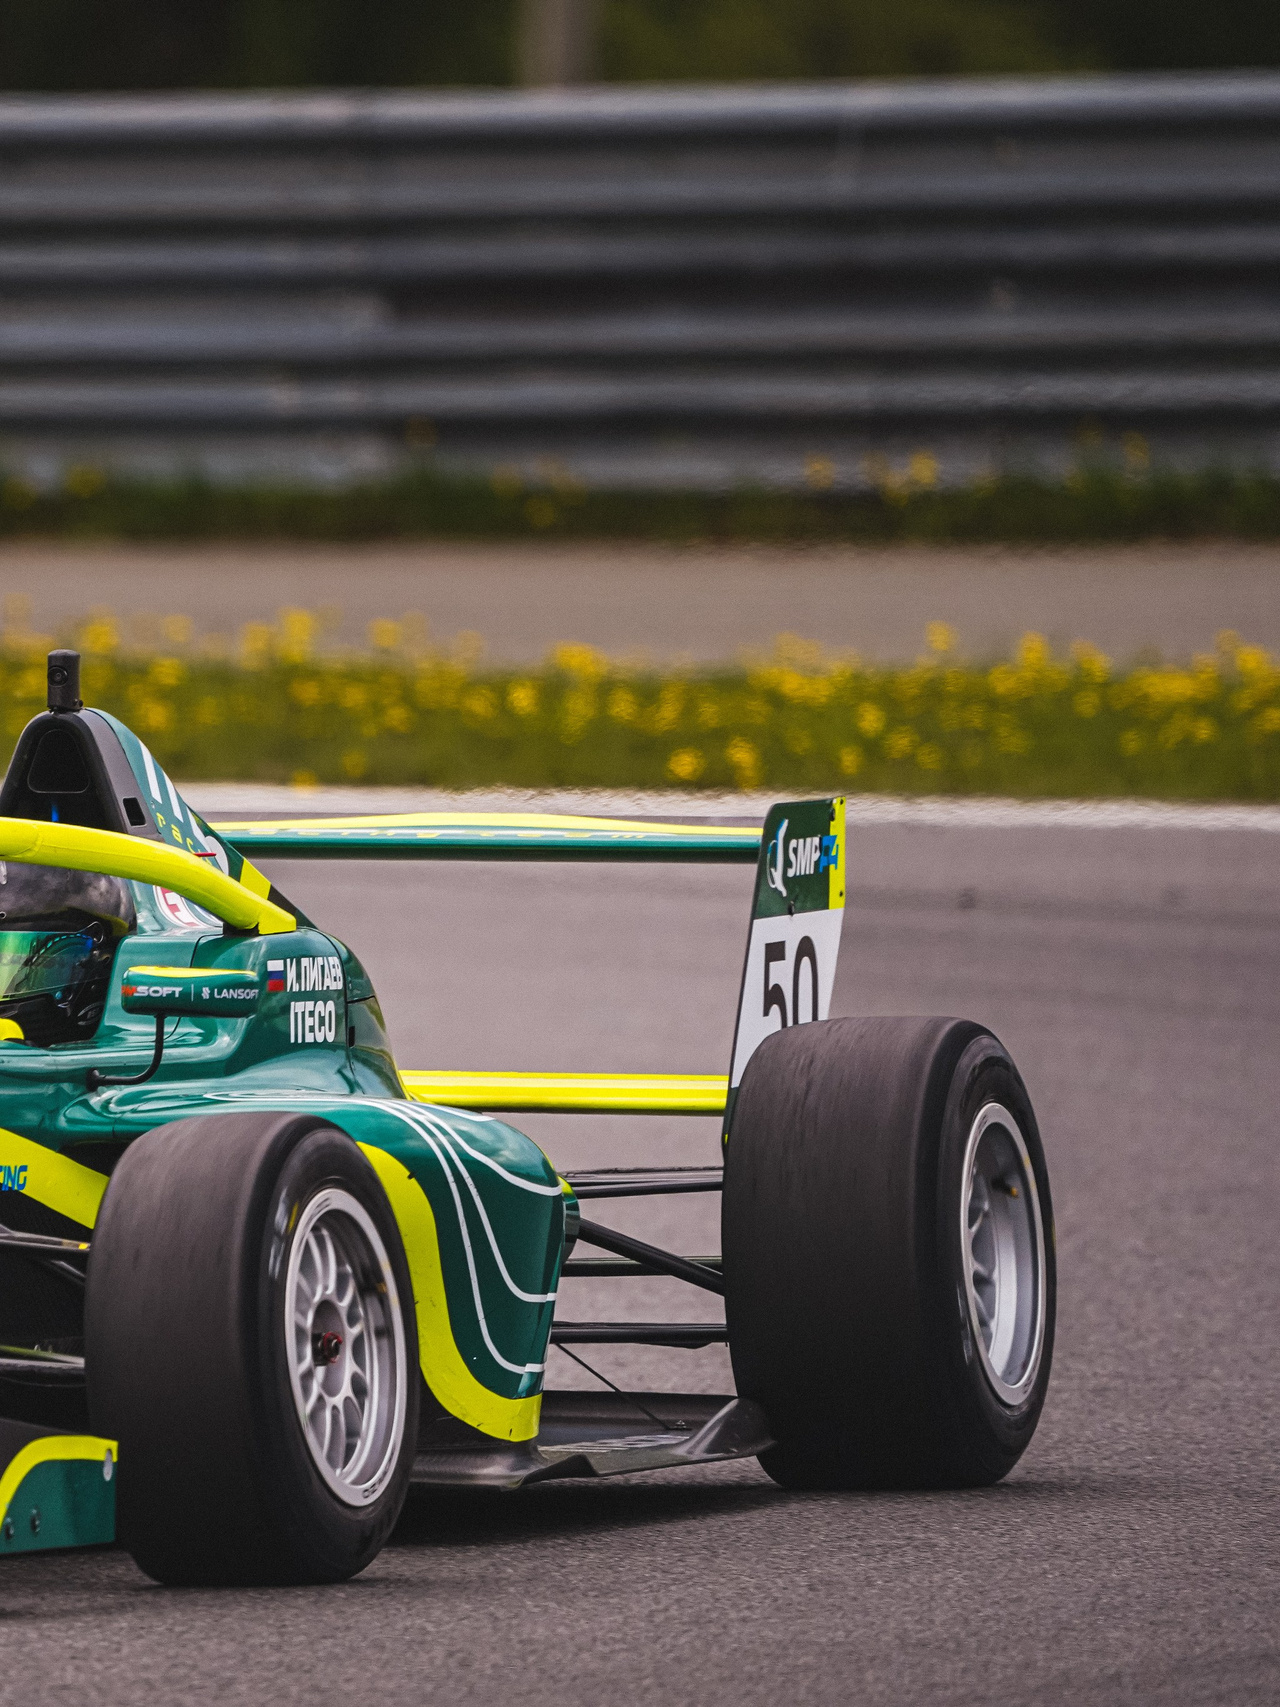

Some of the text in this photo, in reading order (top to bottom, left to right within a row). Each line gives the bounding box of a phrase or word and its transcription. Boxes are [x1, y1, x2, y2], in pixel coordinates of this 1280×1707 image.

[214, 988, 259, 1000] LANSOFT
[763, 935, 819, 1029] 50
[289, 1000, 336, 1043] ITECO
